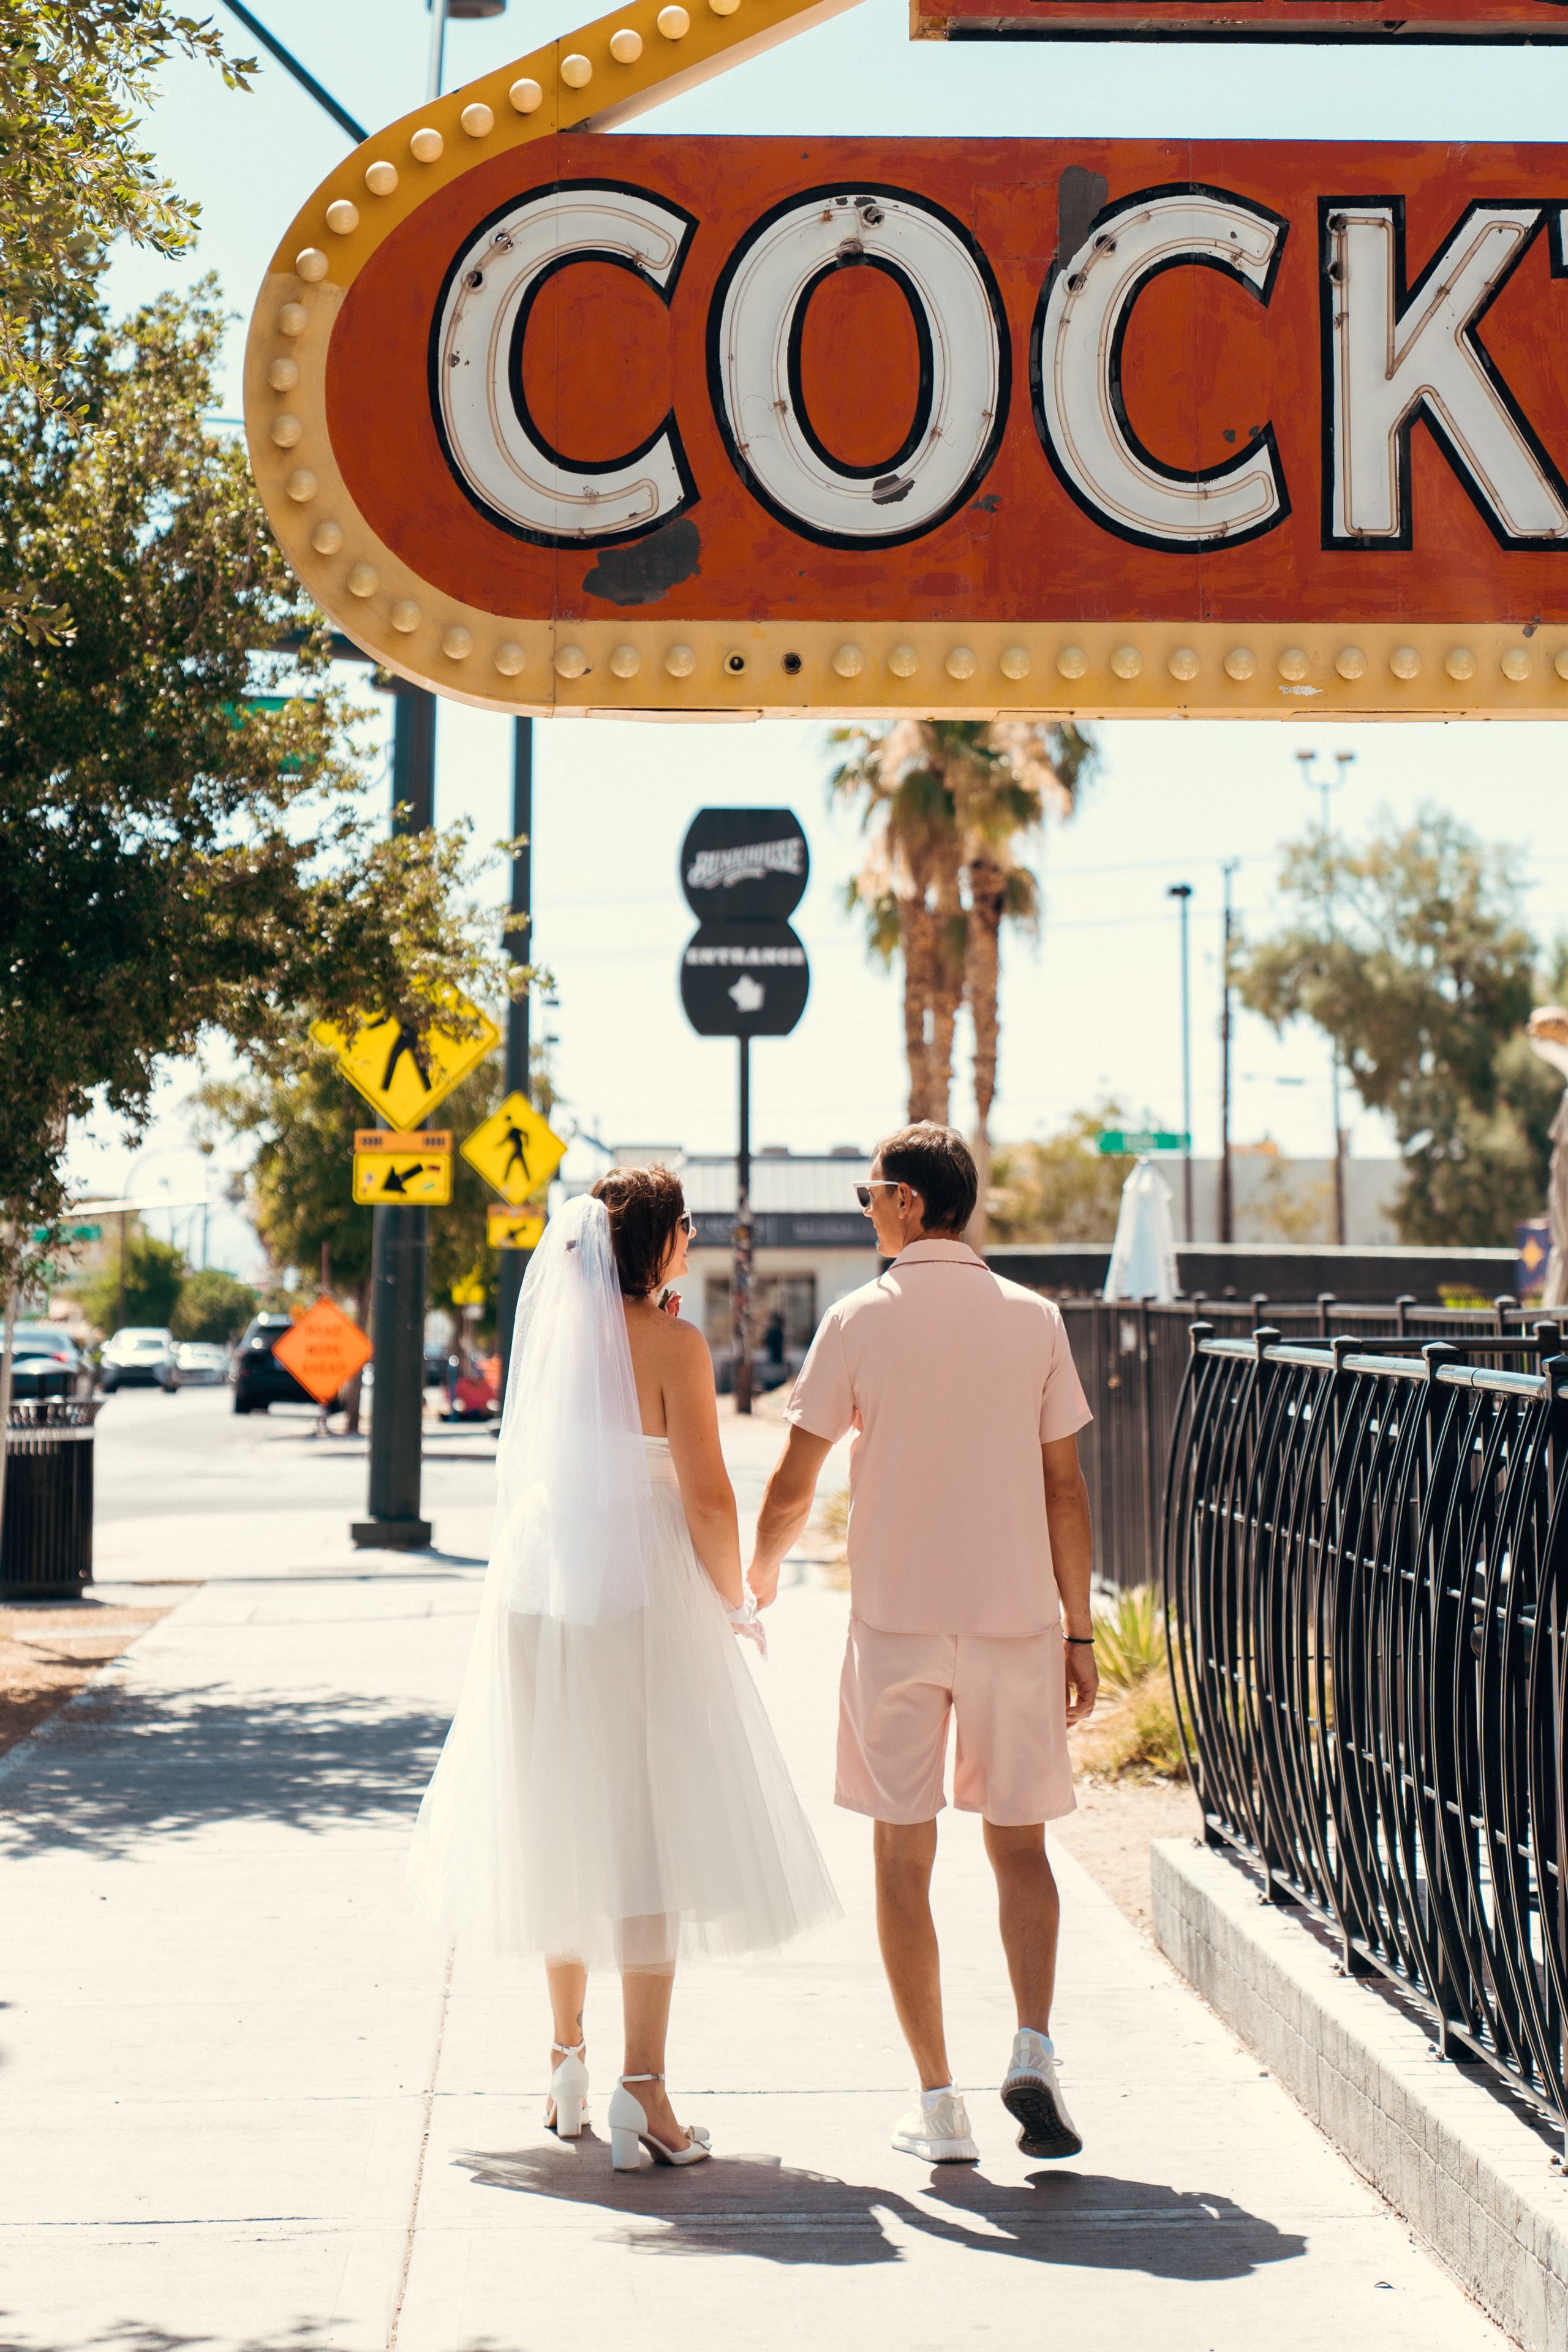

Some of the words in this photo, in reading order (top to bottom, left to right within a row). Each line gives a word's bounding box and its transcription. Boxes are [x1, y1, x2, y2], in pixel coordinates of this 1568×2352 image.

[427, 178, 1568, 552] COCK
[687, 837, 804, 889] BUNKHOUSE
[685, 946, 805, 966] ENTRANCE
